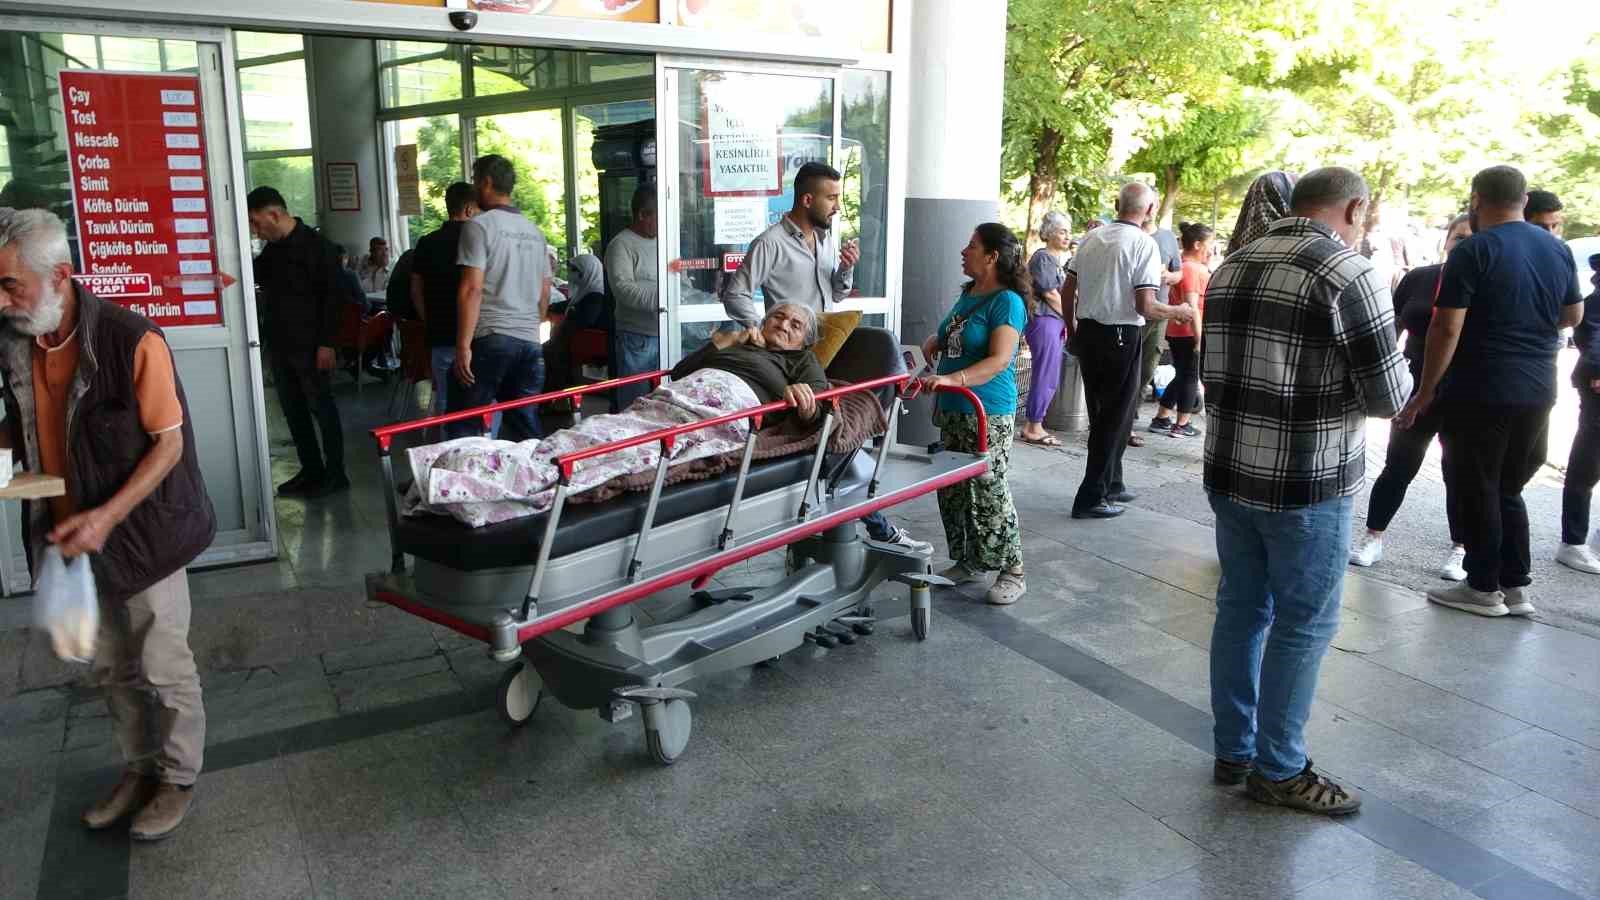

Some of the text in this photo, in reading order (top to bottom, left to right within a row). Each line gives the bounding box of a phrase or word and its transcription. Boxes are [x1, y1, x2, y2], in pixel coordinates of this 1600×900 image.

[68, 86, 90, 106] Çay
[71, 109, 97, 125] Tost
[74, 132, 119, 148] Nescafe
[77, 154, 111, 172] Çorba
[80, 176, 109, 191] Simit
[83, 198, 149, 213] Köfte Dürüm
[85, 219, 154, 235] Tavuk Dürüm
[89, 241, 132, 259] Çiğköfte
[135, 240, 168, 255] Dürüm
[148, 303, 181, 317] Dürüm
